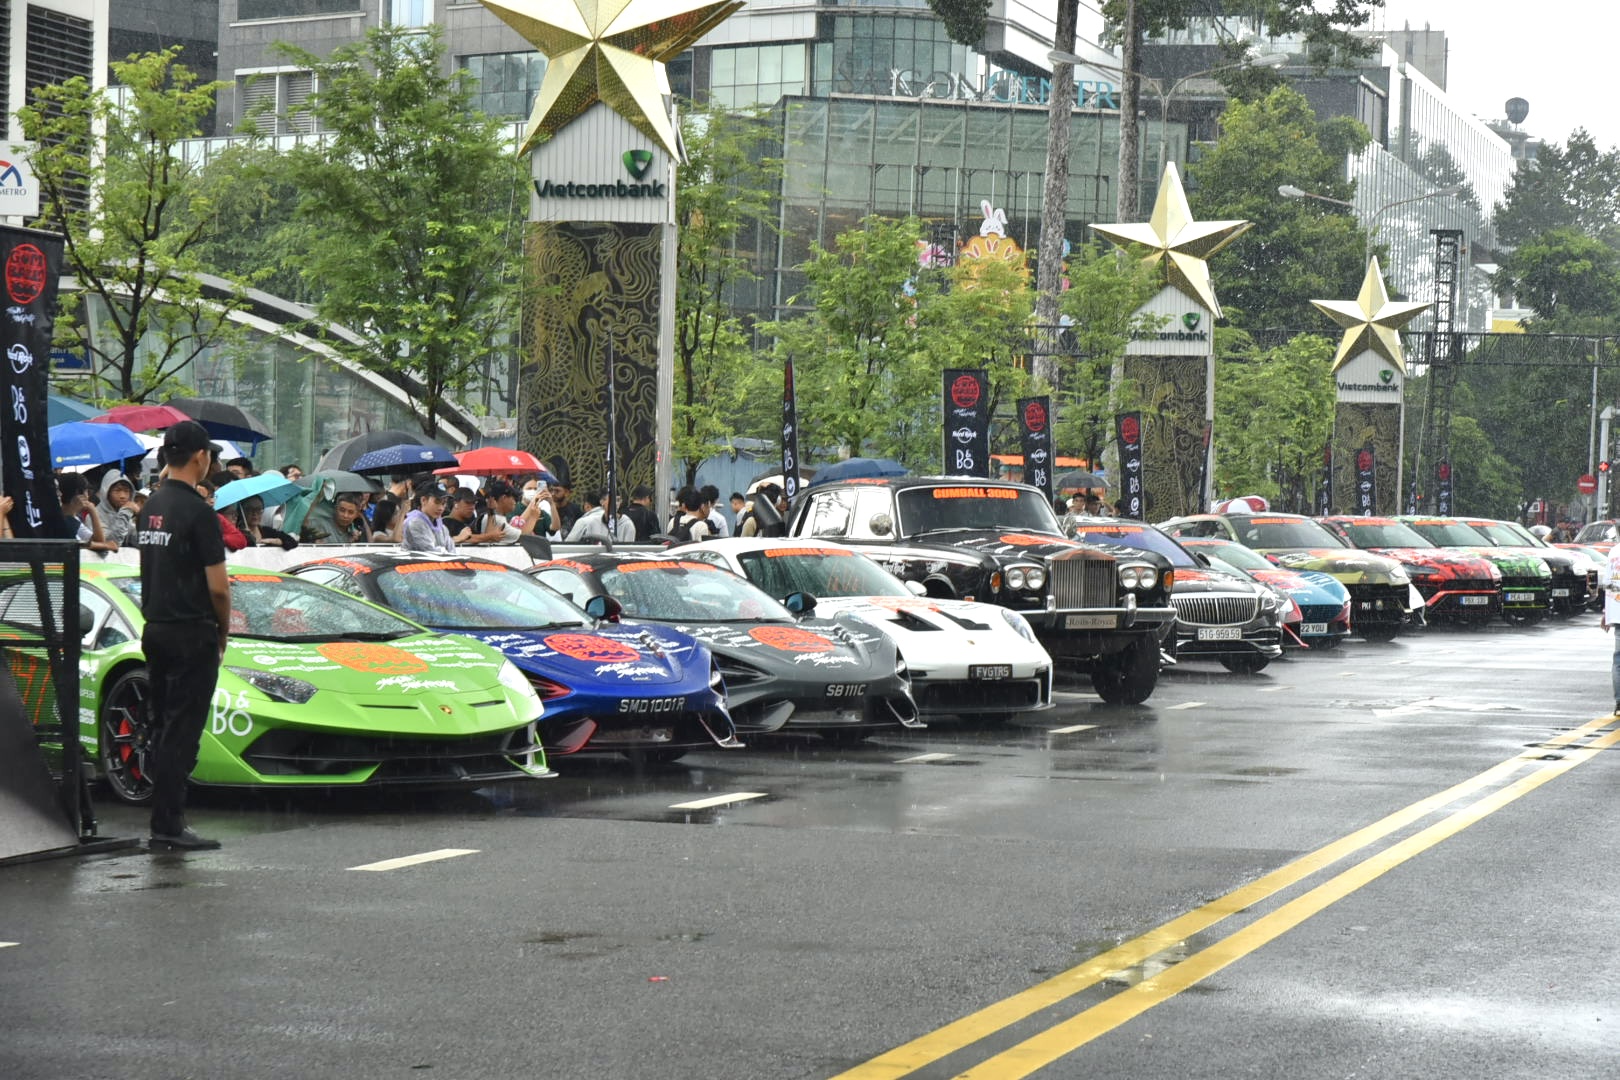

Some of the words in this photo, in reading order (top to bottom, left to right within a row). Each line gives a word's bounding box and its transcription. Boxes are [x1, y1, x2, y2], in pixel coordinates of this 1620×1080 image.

[987, 69, 1119, 110] CENTR
[534, 178, 665, 199] Vietcombank
[1337, 381, 1399, 392] Vietcombank
[933, 488, 986, 499] GUMBALL
[986, 488, 1019, 499] 3000
[138, 531, 173, 546] ECURITY
[826, 684, 866, 697] SB111C
